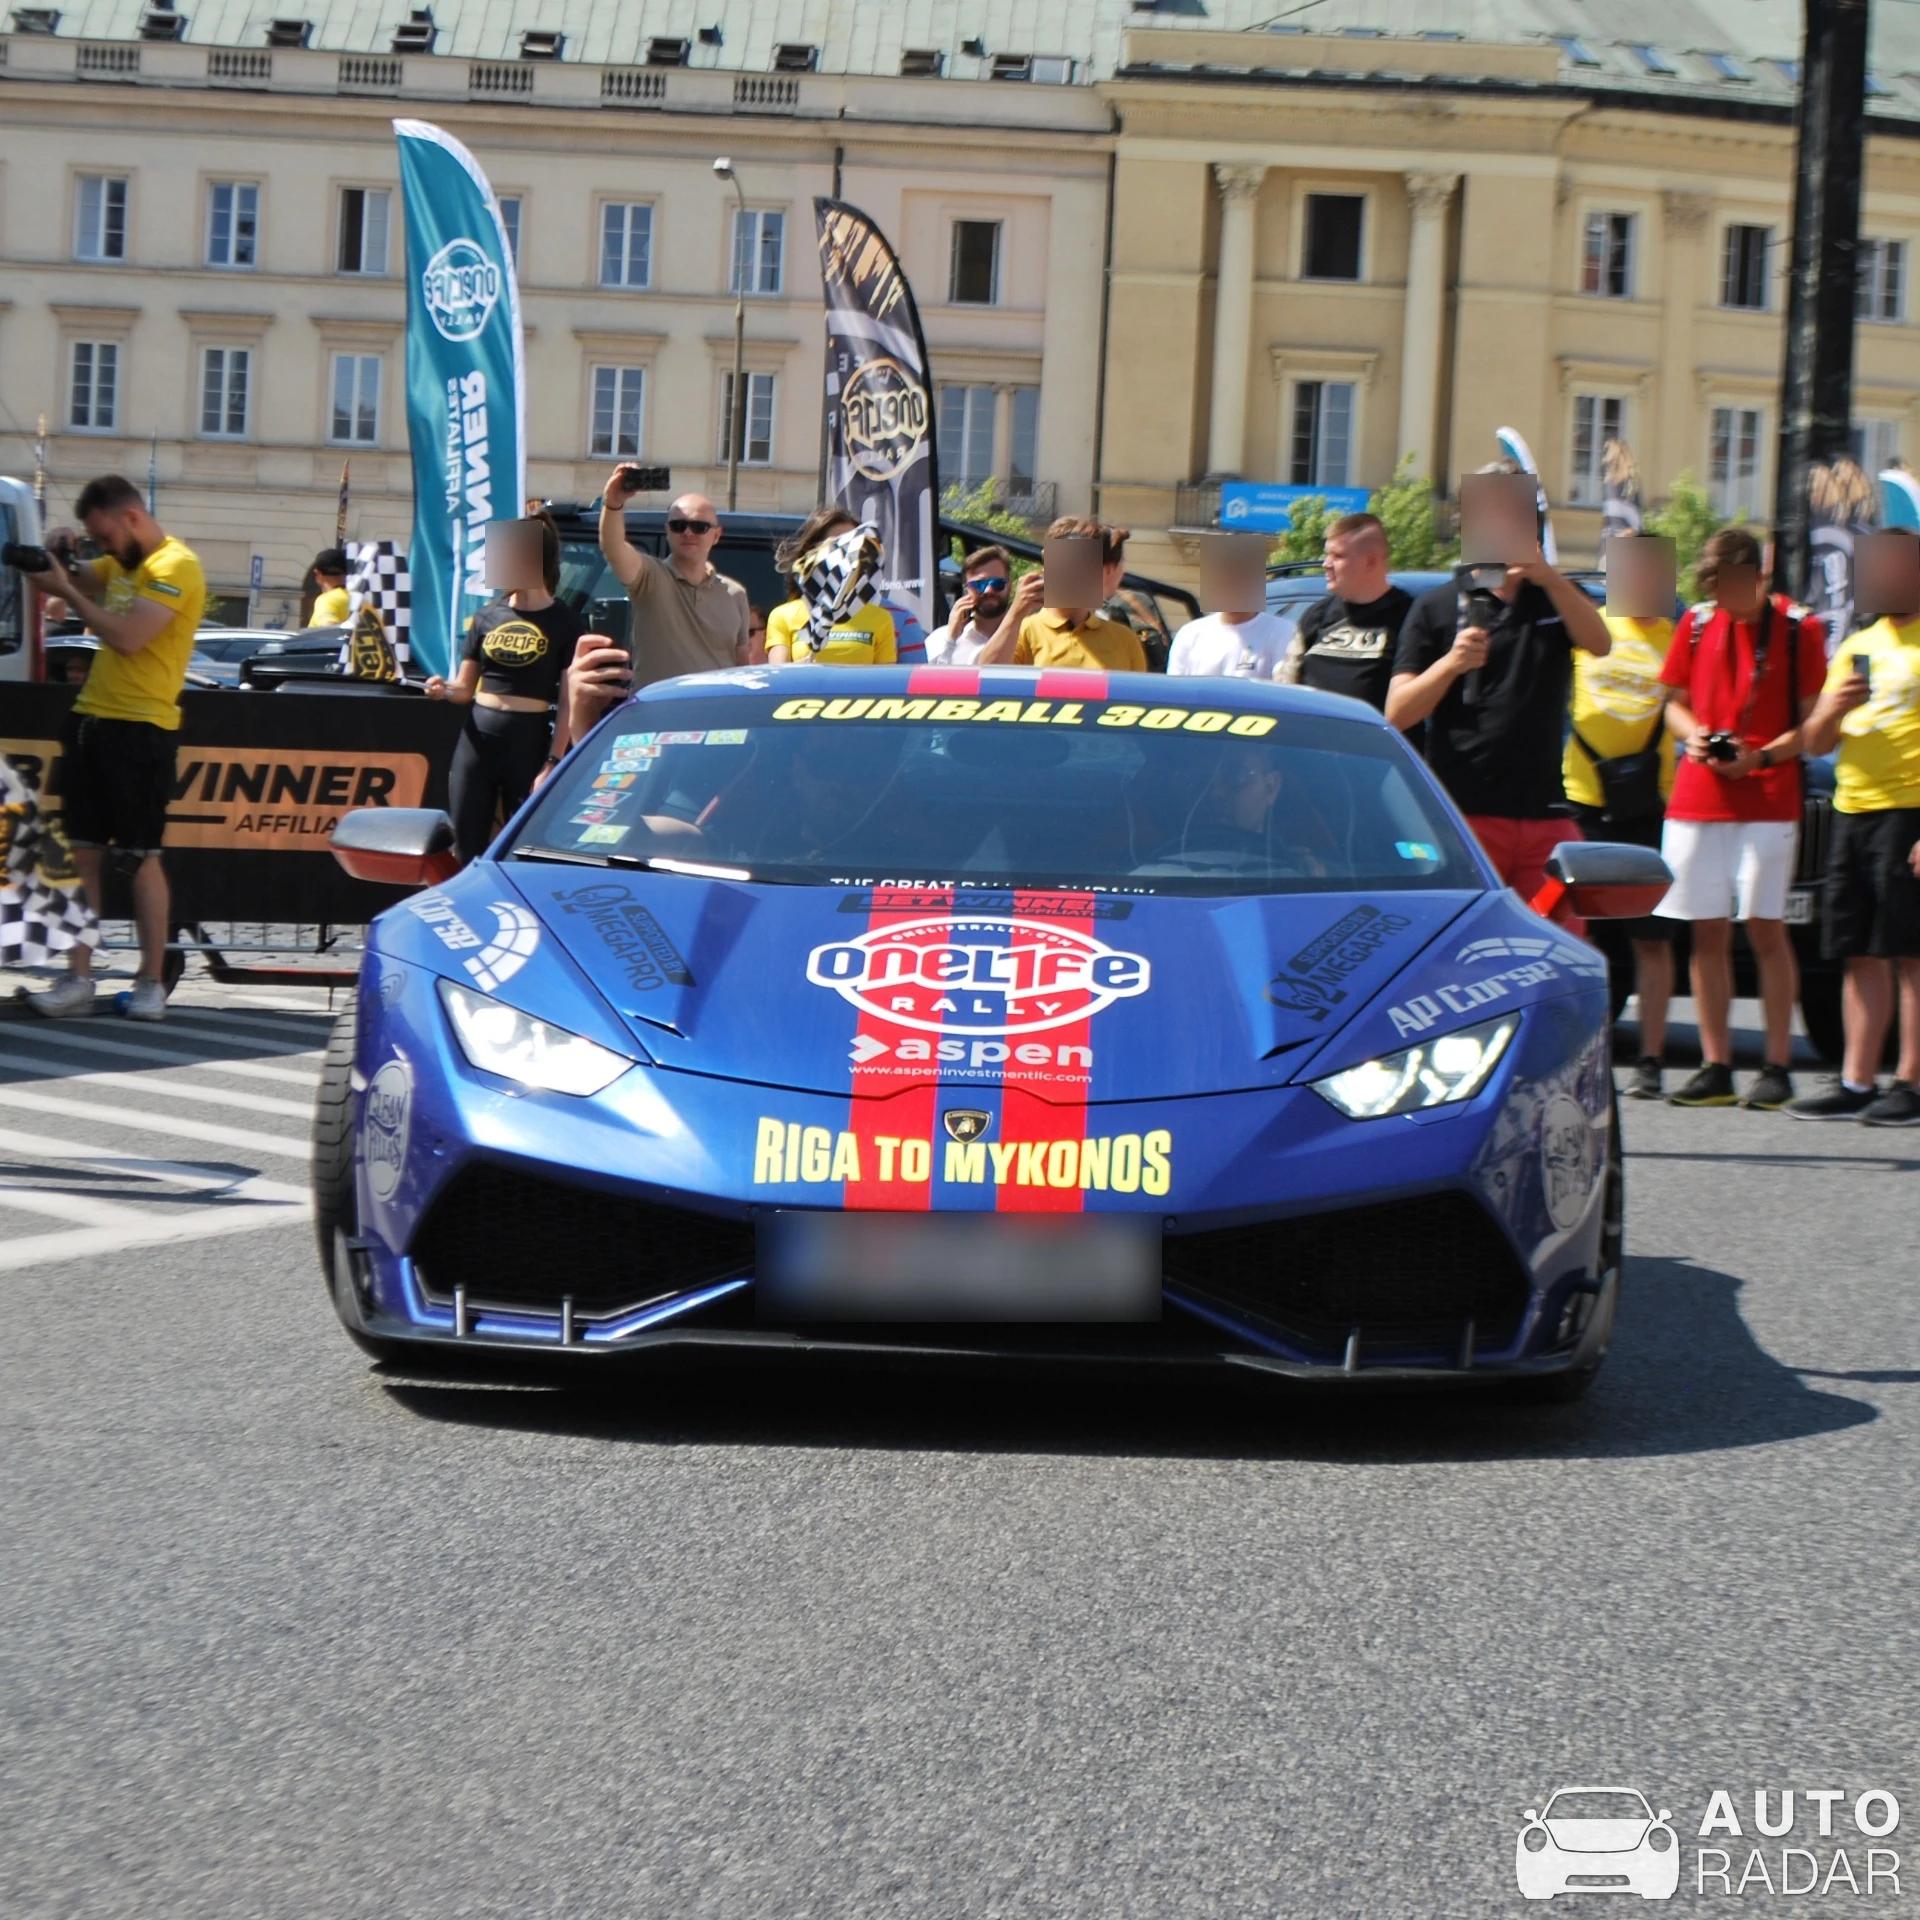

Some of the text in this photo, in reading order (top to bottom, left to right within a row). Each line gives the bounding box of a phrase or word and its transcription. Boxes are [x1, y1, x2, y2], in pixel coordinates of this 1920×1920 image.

[772, 699, 1278, 737] GUMBALL 3000
[235, 814, 338, 836] AFFILIA
[891, 923, 1073, 948] ONELIFERALLY.COM
[1435, 960, 1559, 1014] Corse
[891, 996, 1062, 1016] RALLY
[895, 1037, 1093, 1068] aspen
[848, 1065, 1093, 1083] www.aspeninvestmentllc.com
[753, 1116, 1172, 1196] RIGA TO MYKONOS
